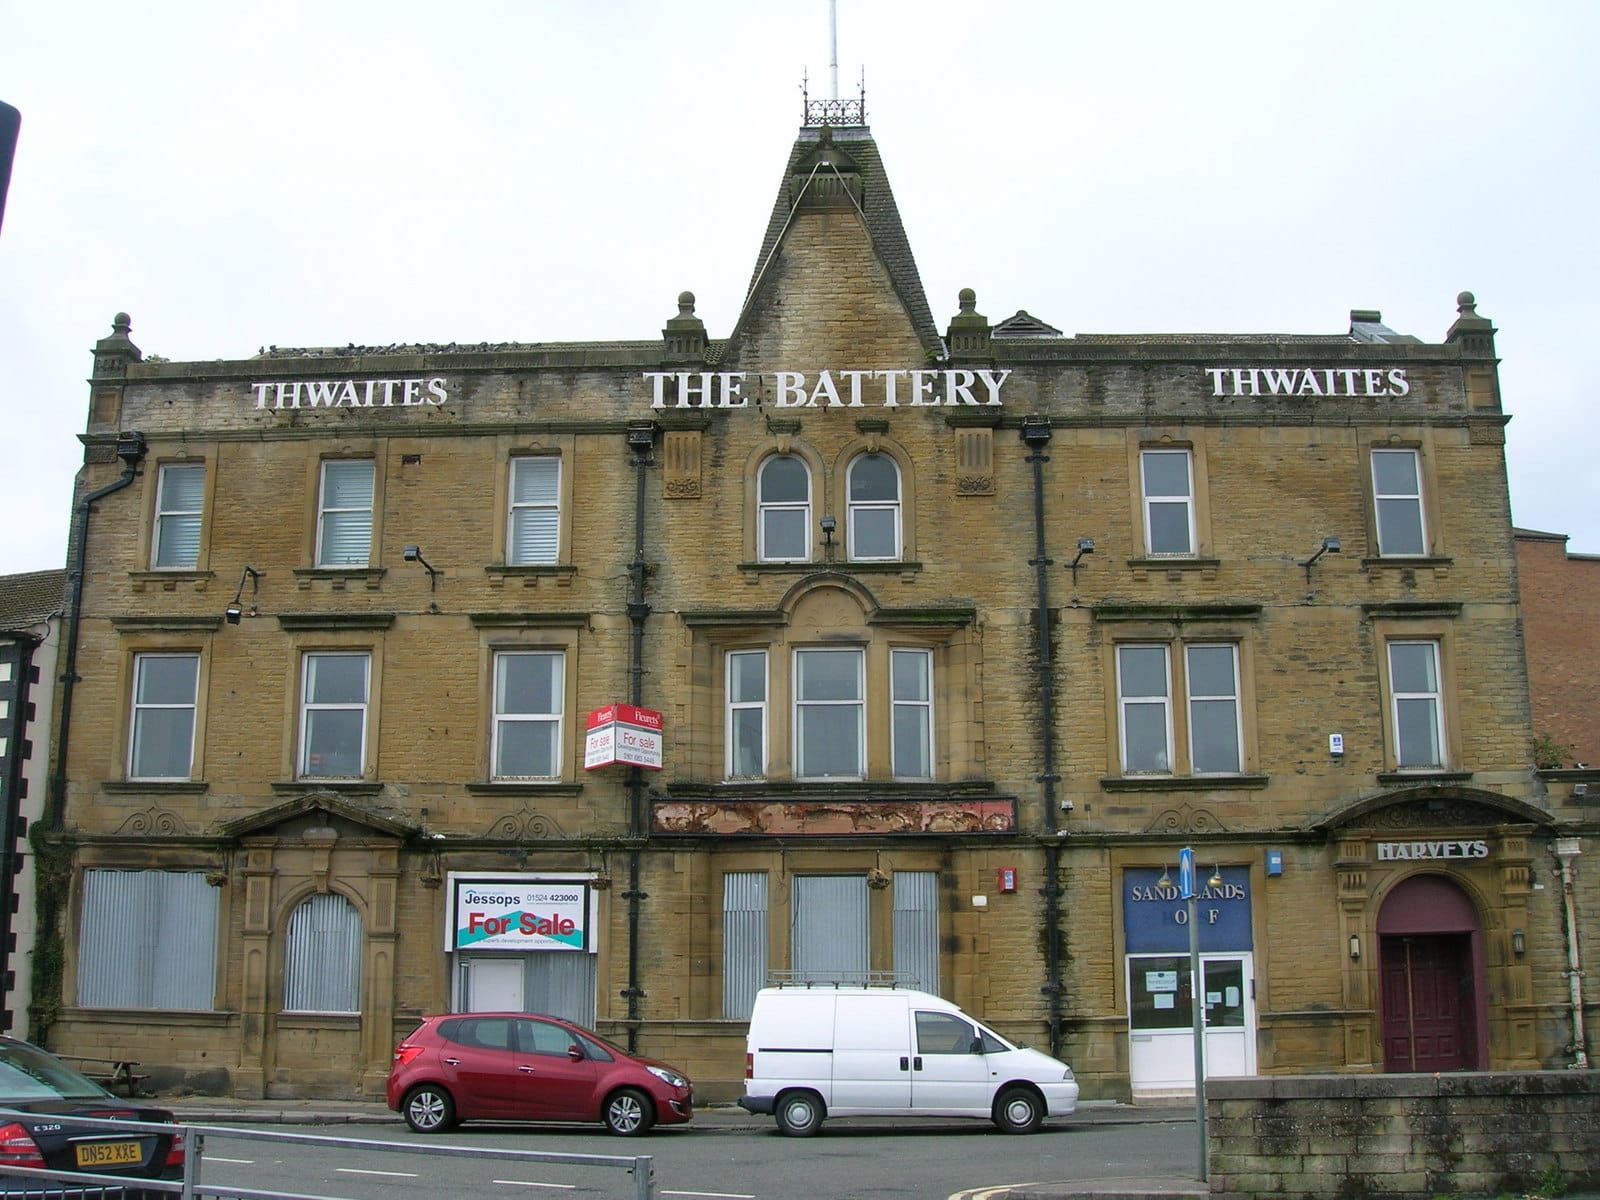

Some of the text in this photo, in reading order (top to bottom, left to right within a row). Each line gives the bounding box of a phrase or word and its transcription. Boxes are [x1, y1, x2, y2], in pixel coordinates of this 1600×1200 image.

[642, 369, 1013, 409] THE BATTERY
[1205, 367, 1410, 397] THWAITES
[251, 377, 448, 410] THWAITES
[623, 732, 655, 750] For sale
[1377, 840, 1489, 861] HARVEYS
[465, 894, 521, 907] Jessops
[526, 894, 579, 902] 01524 423000
[1132, 883, 1246, 901] SANDANDS
[468, 912, 576, 937] For Sale
[43, 1124, 61, 1132] 320
